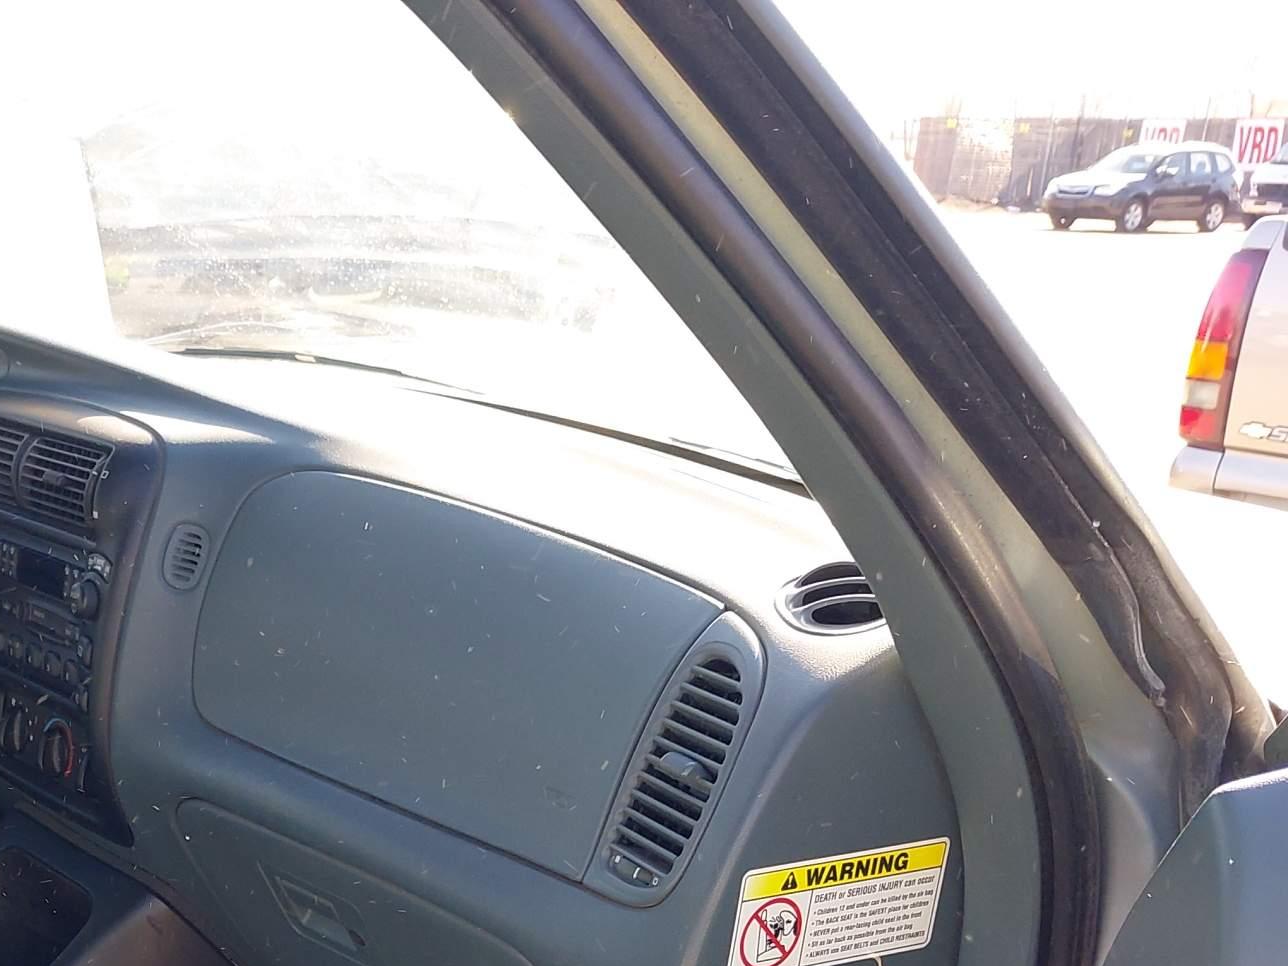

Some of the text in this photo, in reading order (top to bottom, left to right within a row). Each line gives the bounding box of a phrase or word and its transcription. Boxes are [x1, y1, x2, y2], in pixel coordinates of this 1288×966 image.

[1238, 125, 1279, 164] VRD
[806, 851, 909, 887] WARNING
[814, 875, 935, 903] DEATH or SERIOUS INJURY can occur
[817, 906, 838, 915] Children
[839, 904, 845, 912] 12
[902, 893, 908, 901] by
[825, 915, 839, 924] BACK
[840, 913, 854, 921] SEAT
[868, 907, 887, 917] SAFEST
[887, 905, 901, 914] place
[909, 900, 929, 909] children
[813, 928, 830, 937] NEVER
[871, 917, 884, 926] child
[834, 935, 846, 943] back
[875, 927, 887, 935] from
[809, 948, 830, 958] ALWAYS
[840, 943, 853, 952] SEAT
[853, 941, 869, 950] BELTS
[879, 935, 895, 945] CHILD
[895, 930, 925, 941] RESTRAINTS
